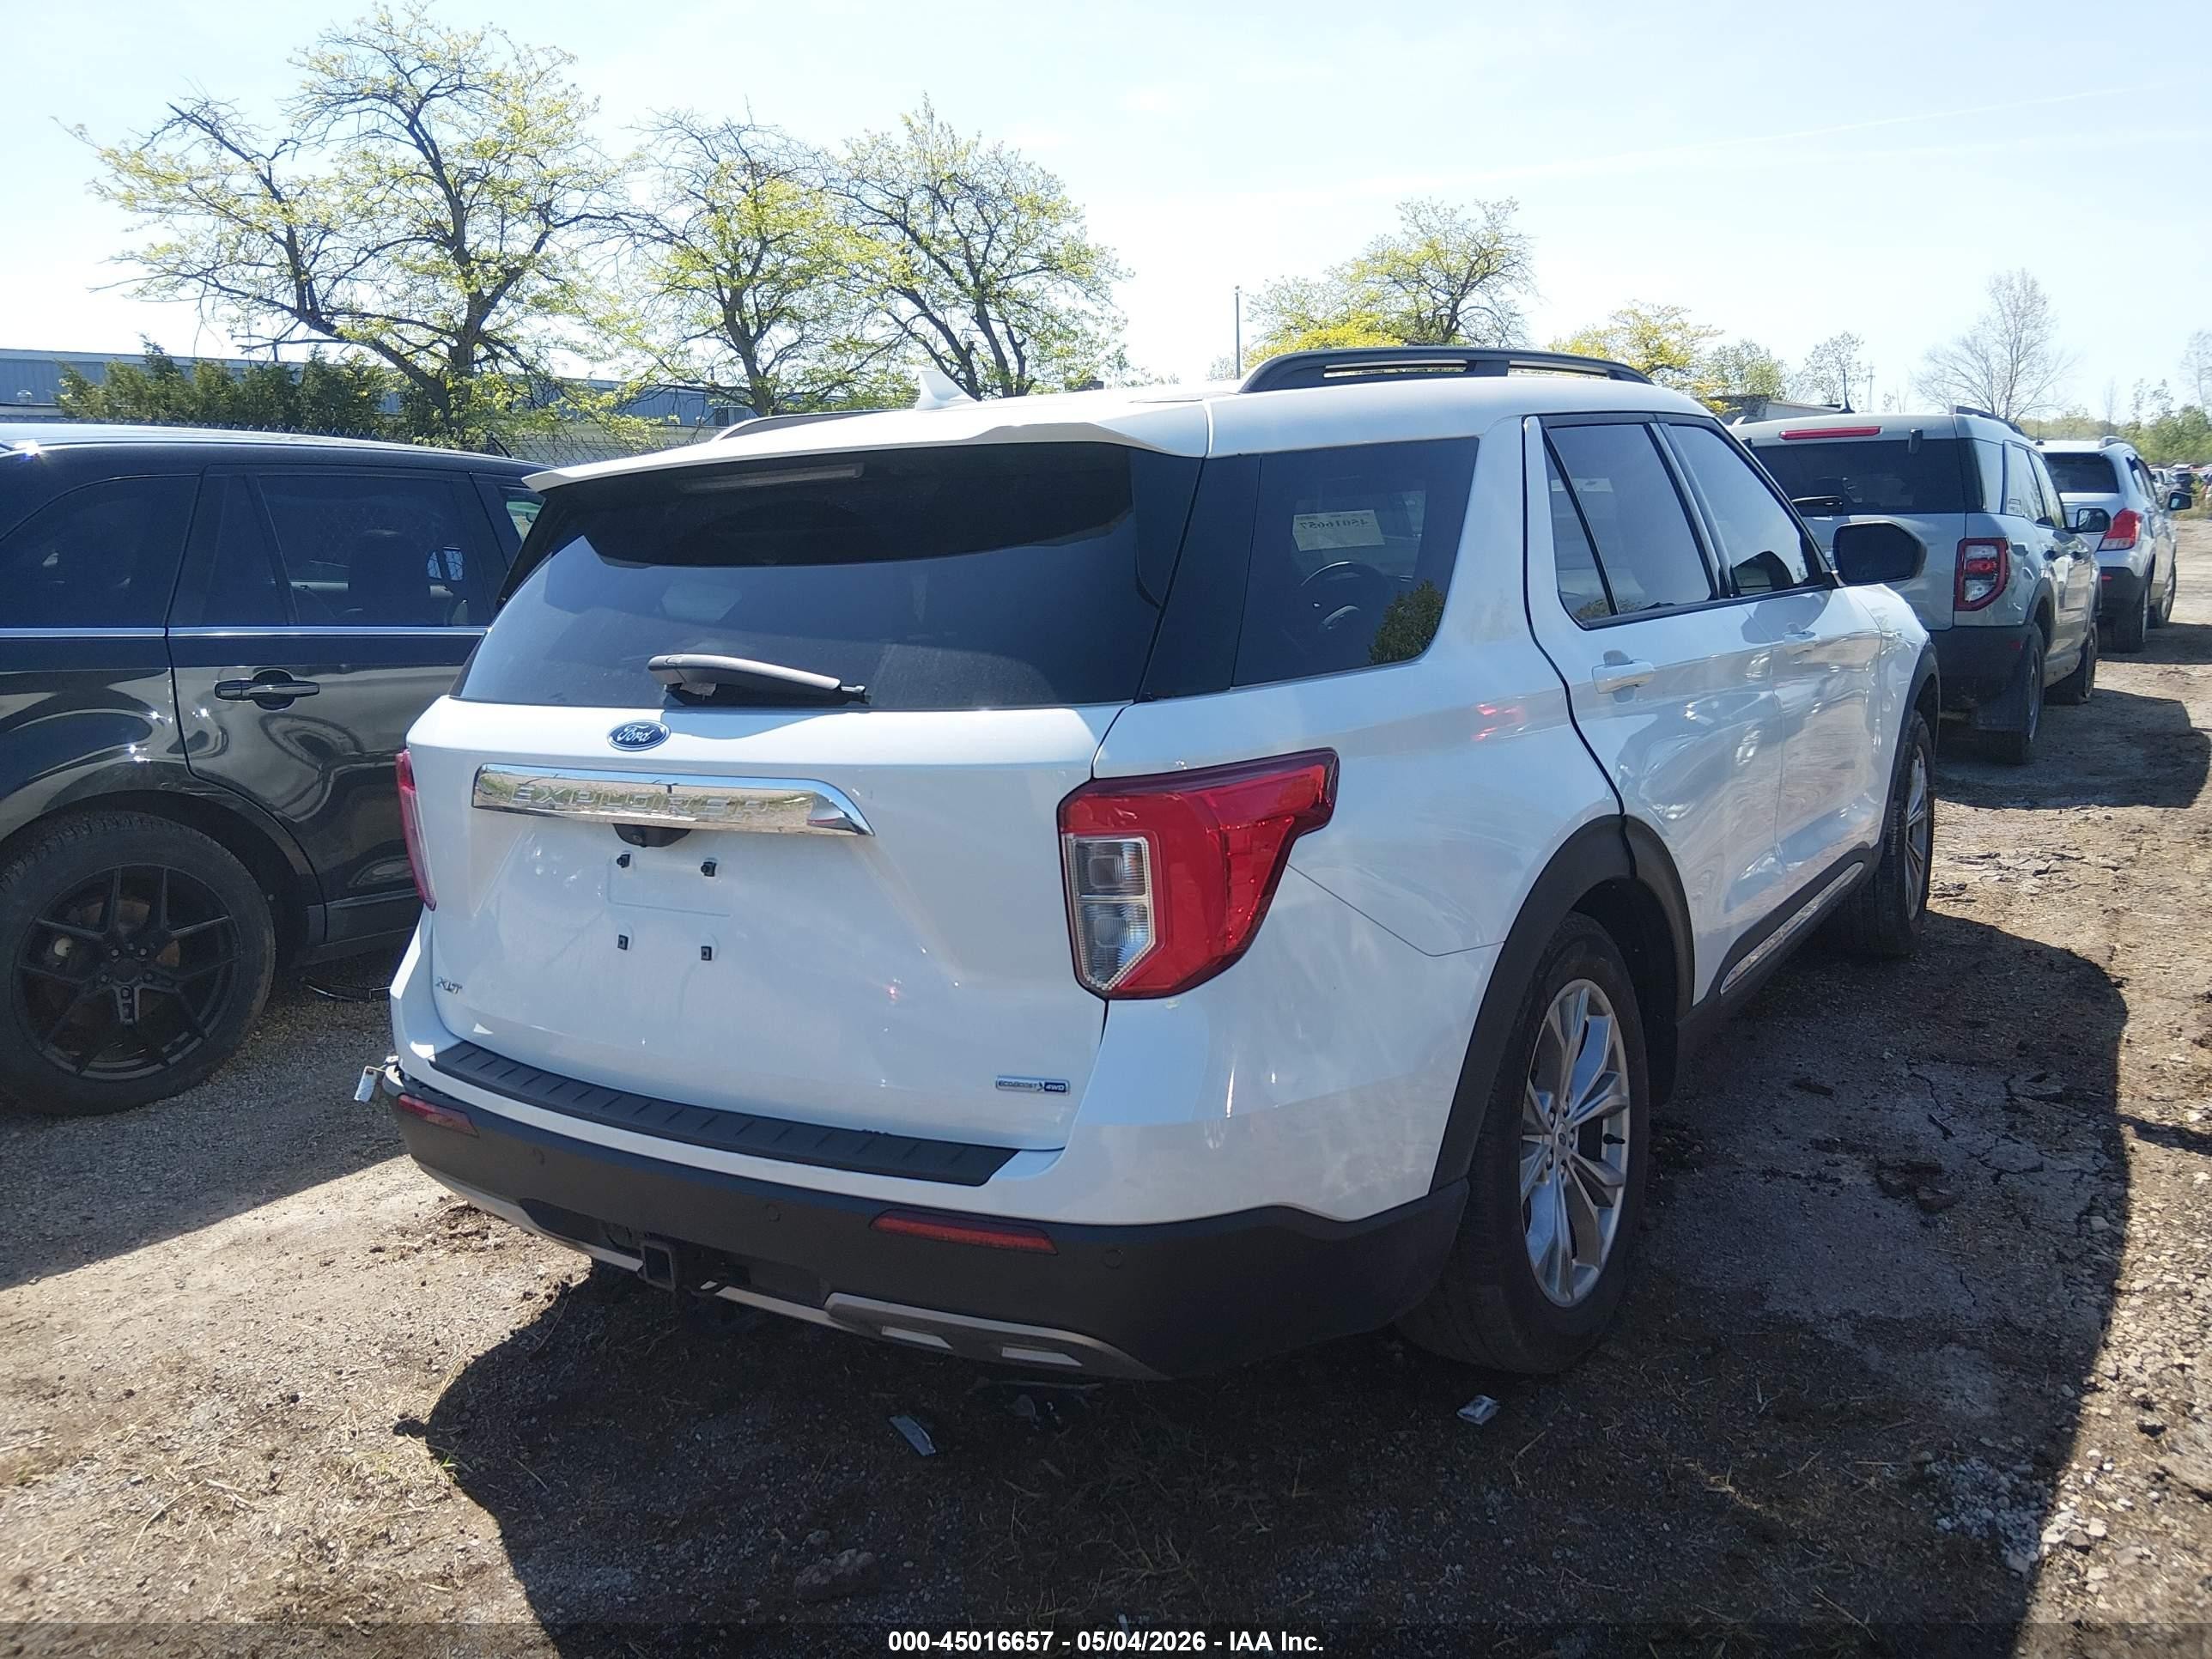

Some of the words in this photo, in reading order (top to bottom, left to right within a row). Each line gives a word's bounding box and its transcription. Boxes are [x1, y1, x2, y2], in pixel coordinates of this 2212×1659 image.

[617, 725, 655, 742] Ford
[510, 782, 773, 819] EXPLORER
[434, 975, 463, 995] XLT
